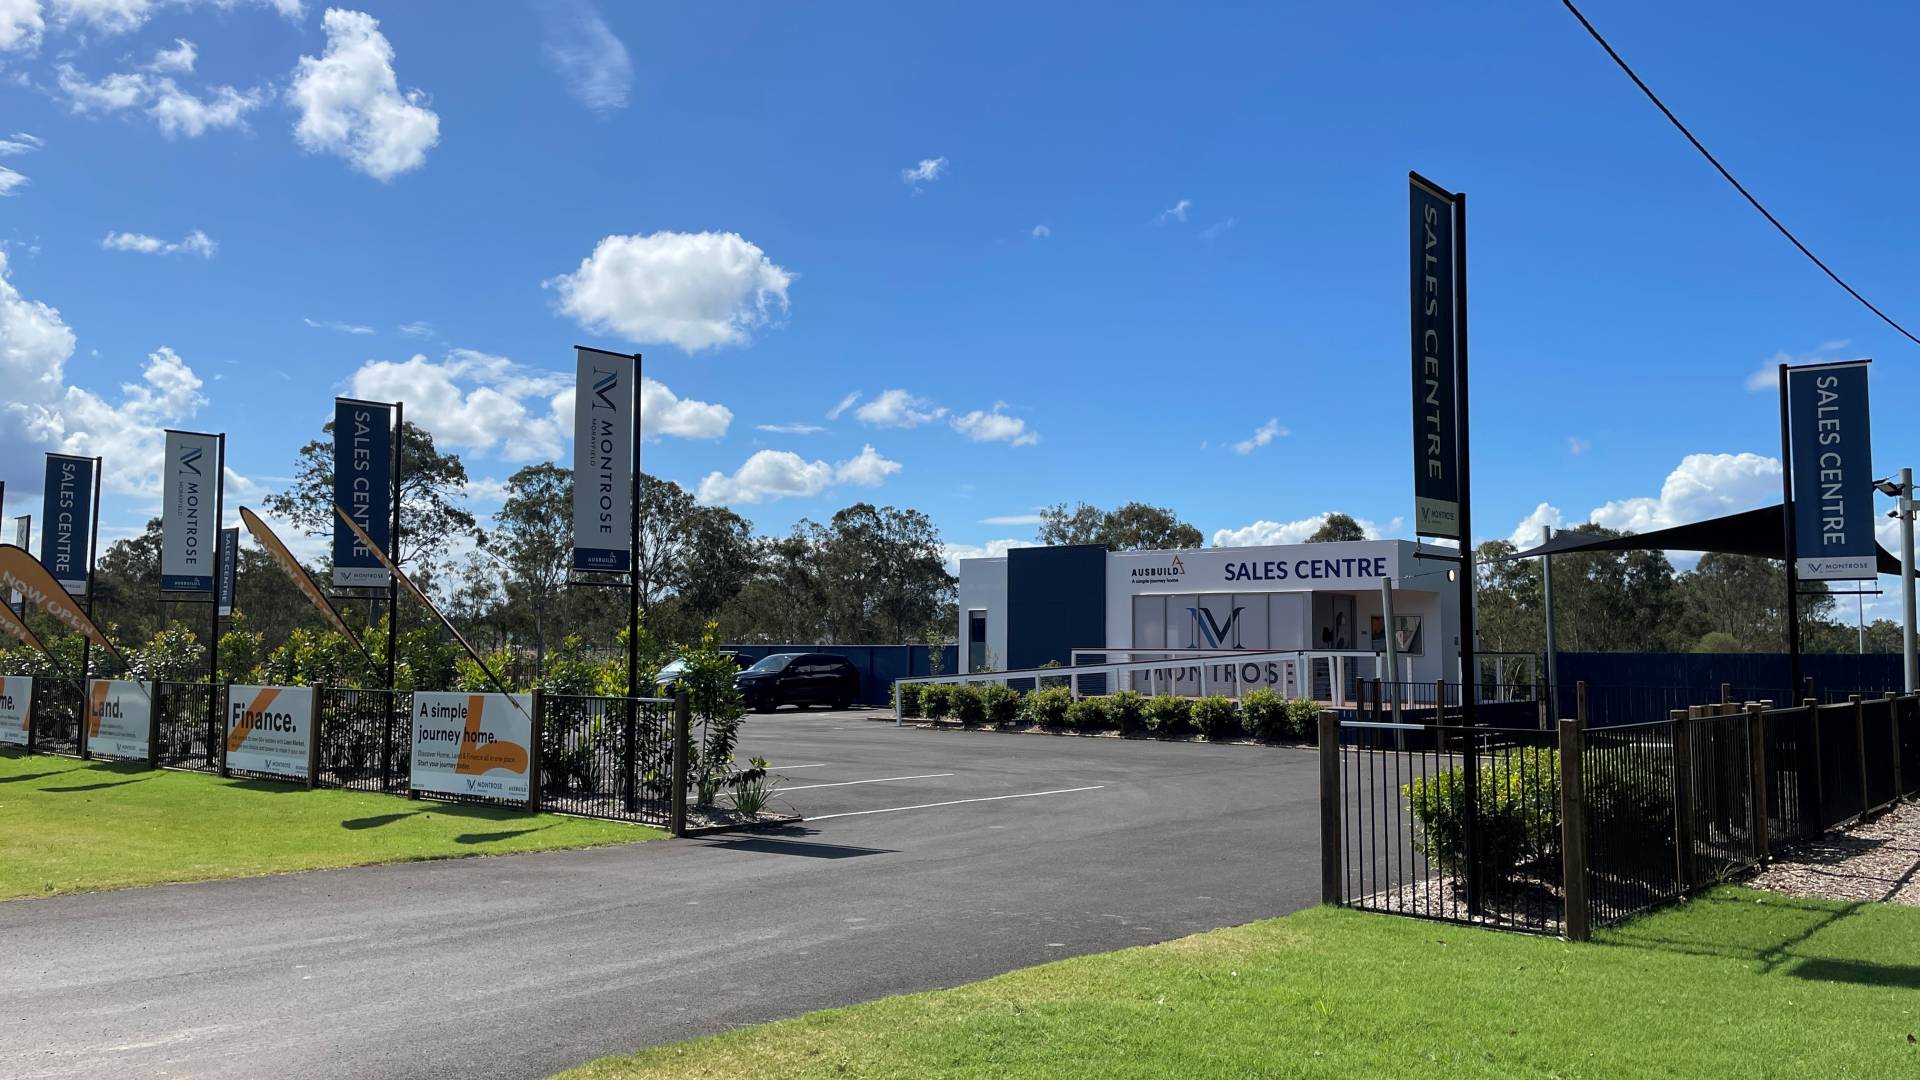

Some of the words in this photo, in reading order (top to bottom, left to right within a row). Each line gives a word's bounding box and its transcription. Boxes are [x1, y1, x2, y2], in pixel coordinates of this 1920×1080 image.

[1424, 203, 1438, 317] SALES
[1424, 329, 1442, 480] CENTRE
[1816, 376, 1840, 445] SALES
[354, 410, 371, 471] SALES
[59, 462, 76, 509] SALES
[600, 420, 614, 534] MONTROSE
[1820, 452, 1845, 545] CENTRE
[56, 512, 73, 573] CENTRE
[185, 482, 199, 565] MONTROSE
[1131, 567, 1179, 576] AUSBUILD
[1224, 560, 1289, 581] SALES
[1294, 557, 1387, 579] CENTRE
[3, 570, 48, 605] NOW
[47, 601, 94, 636] OPEN
[92, 696, 123, 718] Land.
[232, 702, 296, 733] Finance.
[418, 725, 461, 745] journey
[464, 727, 497, 743] home.
[420, 702, 428, 718] A
[431, 702, 468, 721] simple
